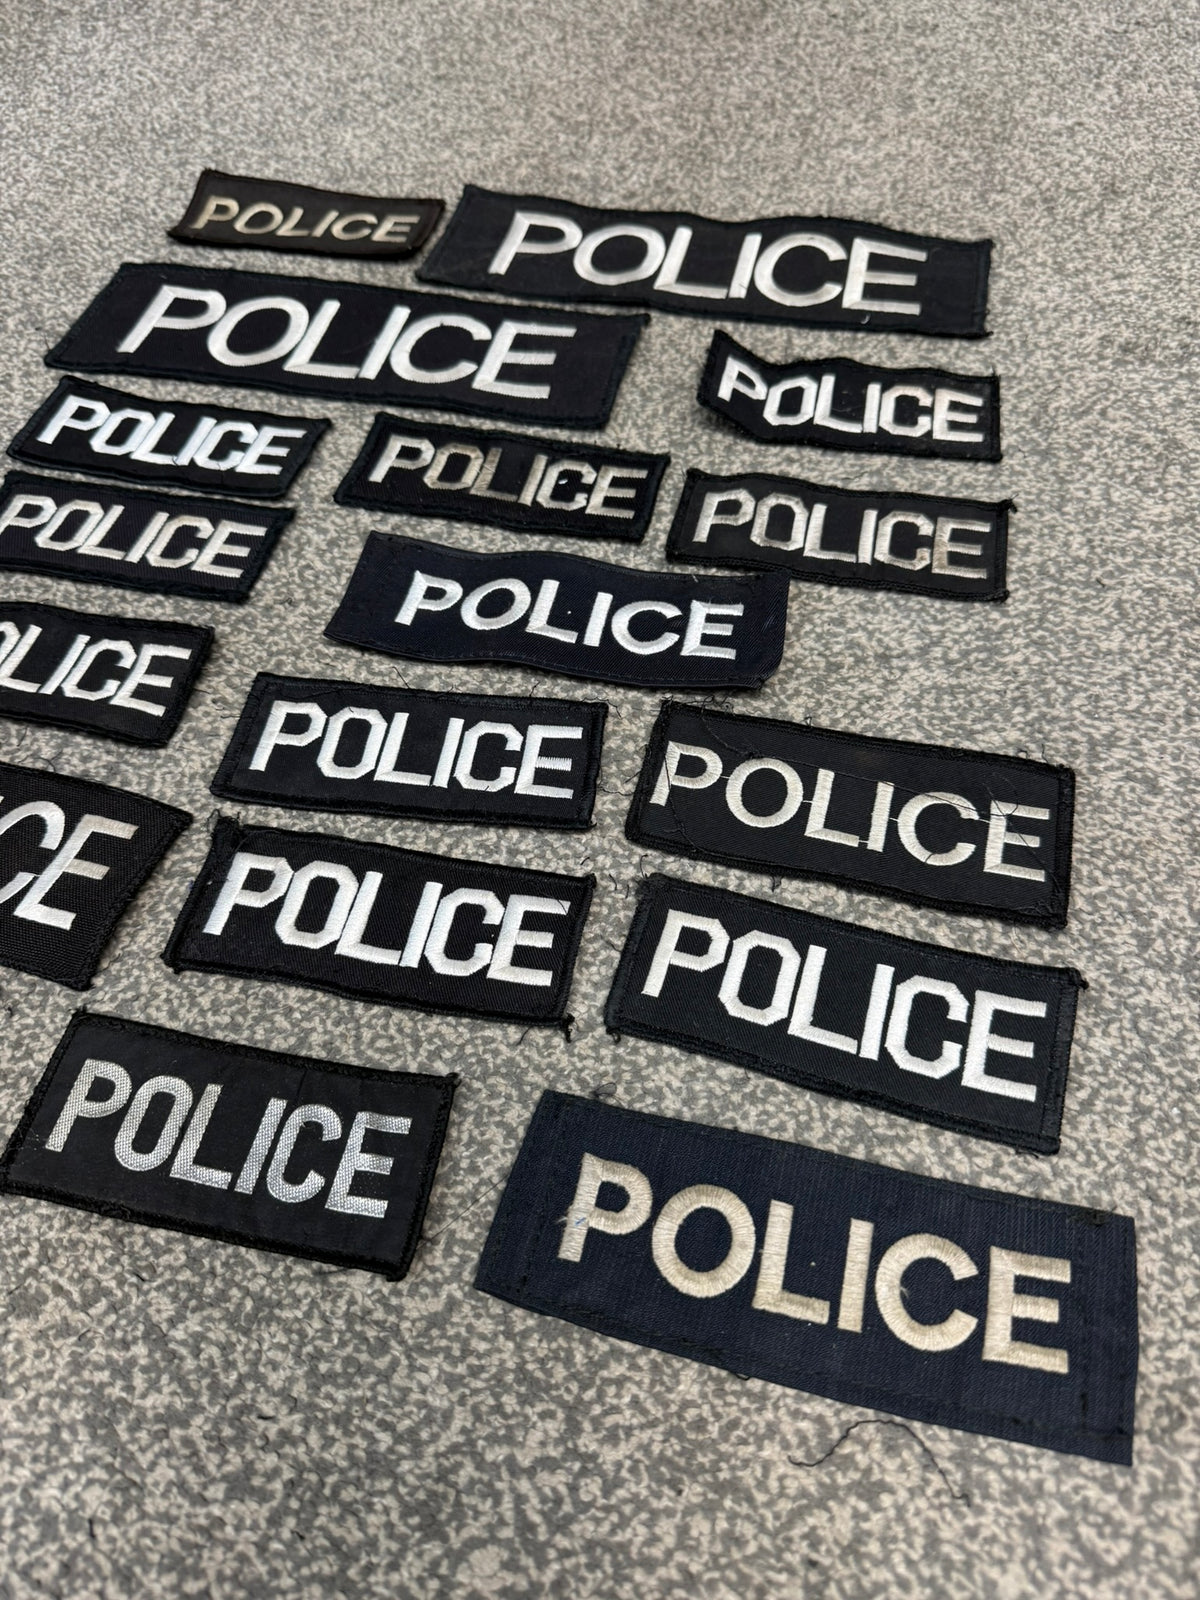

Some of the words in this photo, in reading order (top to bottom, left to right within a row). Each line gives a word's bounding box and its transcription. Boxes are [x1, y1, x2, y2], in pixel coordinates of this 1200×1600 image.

[192, 197, 420, 243] POLICE
[488, 210, 928, 316] POLICE
[116, 284, 576, 399] POLICE
[37, 396, 306, 475] POLICE
[717, 356, 984, 442] POLICE
[368, 437, 649, 518] POLICE
[0, 494, 267, 578] POLICE
[693, 489, 992, 579] POLICE
[394, 570, 744, 659] POLICE
[249, 701, 583, 799] POLICE
[650, 741, 1051, 882] POLICE
[203, 852, 570, 985] POLICE
[641, 909, 1048, 1102] POLICE
[45, 1059, 412, 1219] POLICE
[559, 1153, 1072, 1375] POLICE
